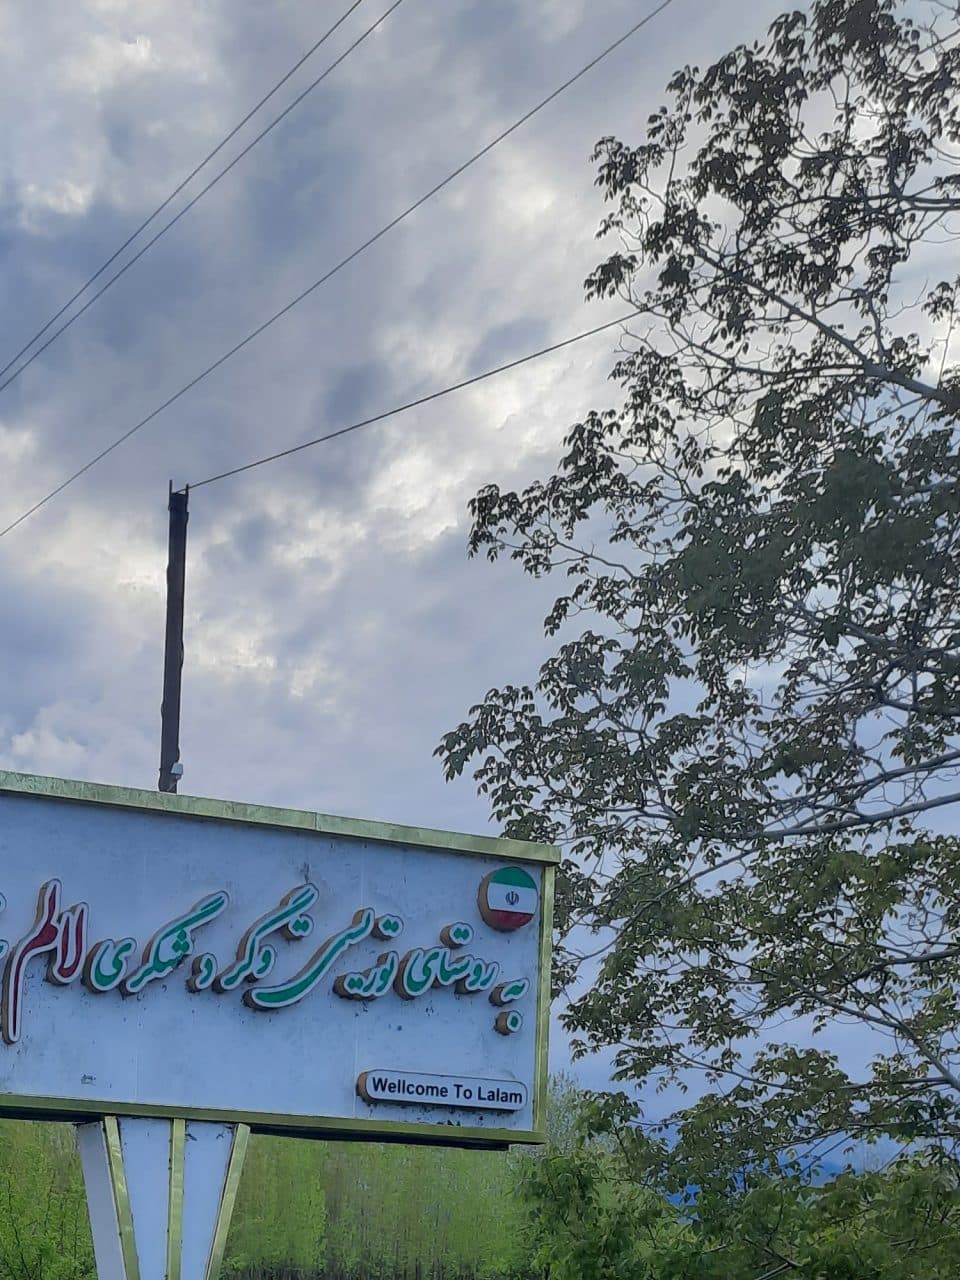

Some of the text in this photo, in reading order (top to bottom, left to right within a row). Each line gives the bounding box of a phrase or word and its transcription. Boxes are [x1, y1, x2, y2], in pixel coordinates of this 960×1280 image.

[3, 879, 88, 1043] لالم
[404, 922, 499, 996] روستای
[503, 977, 528, 1031] به
[372, 1077, 523, 1104] Wellcome To Lalam
